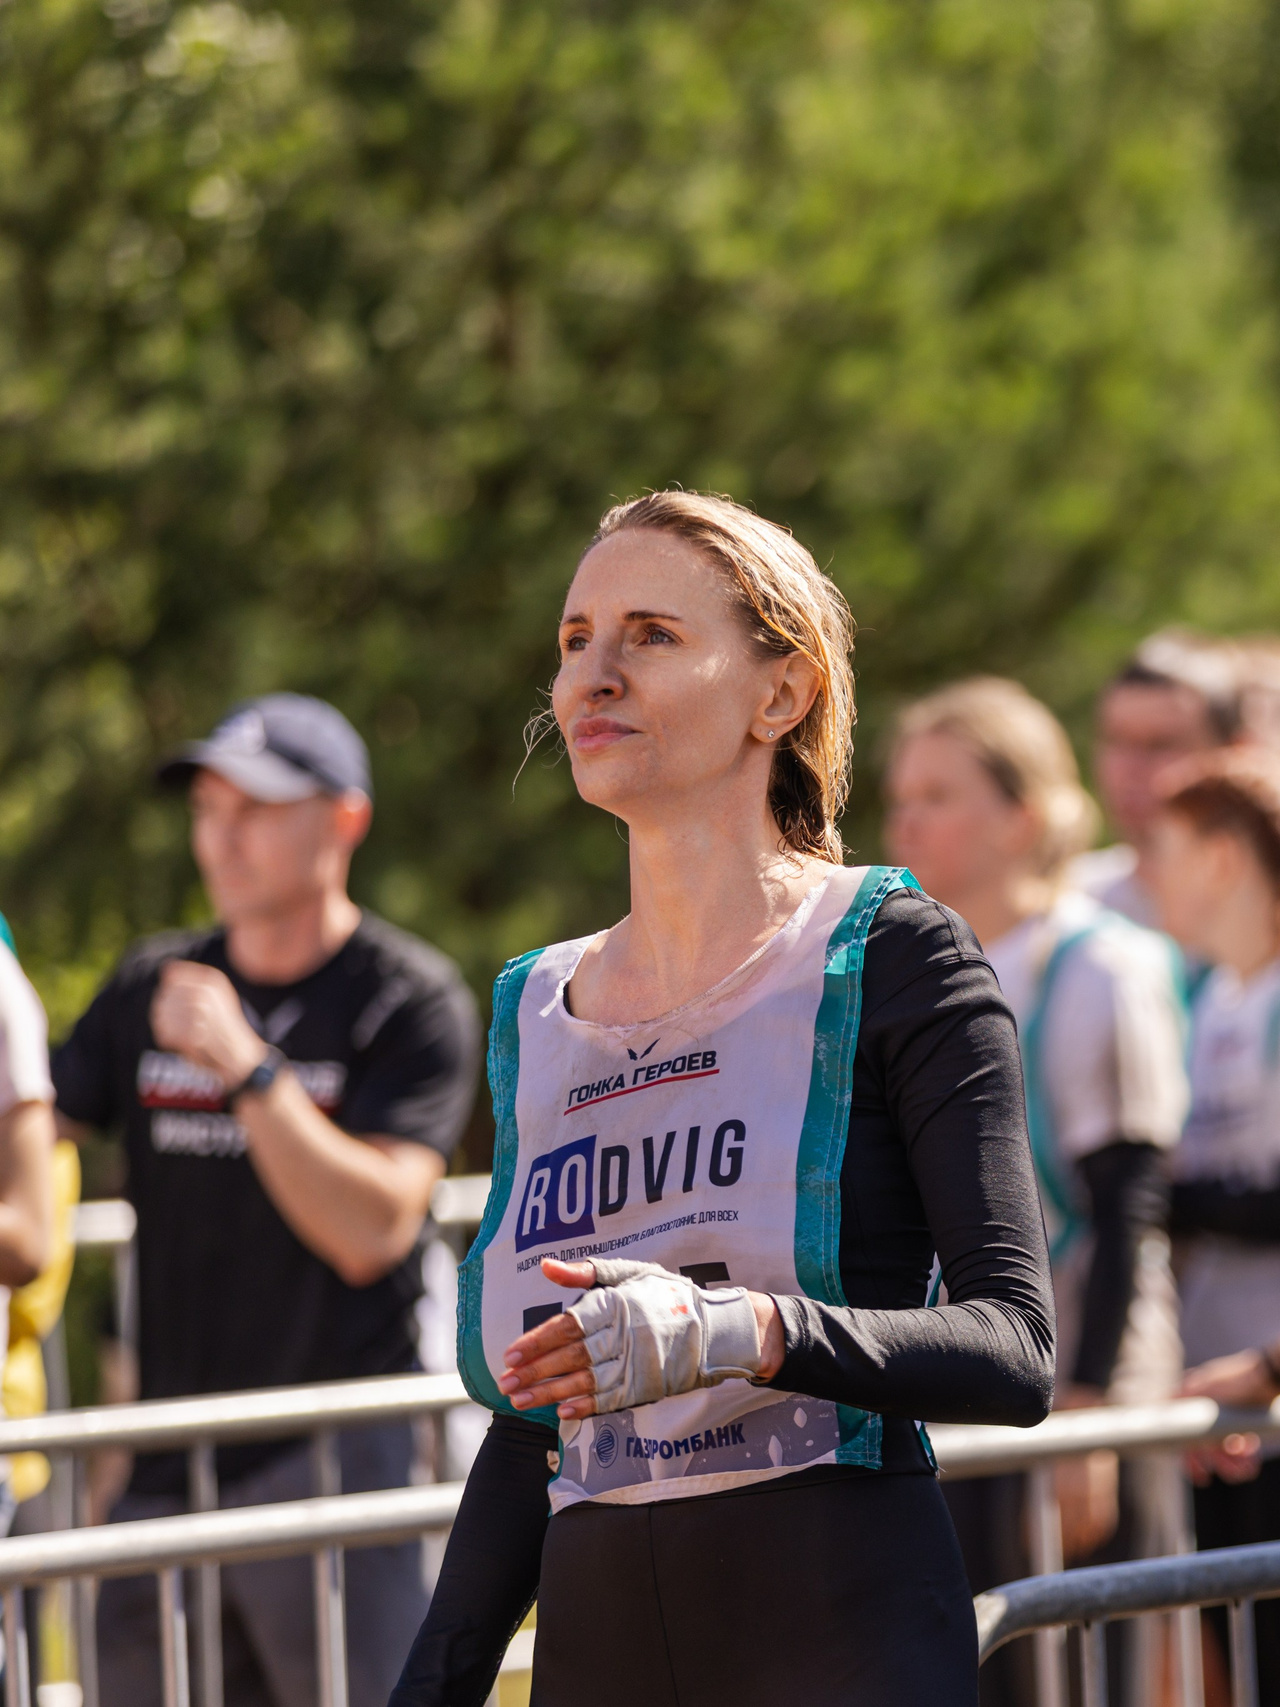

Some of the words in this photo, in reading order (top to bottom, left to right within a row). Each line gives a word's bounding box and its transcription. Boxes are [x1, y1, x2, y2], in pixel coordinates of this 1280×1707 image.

[567, 1073, 626, 1108] ГОНКА
[632, 1050, 717, 1086] ГЕРОЕВ
[521, 1119, 746, 1236] RODVIG
[560, 1248, 576, 1262] ДЛЯ
[698, 1210, 717, 1225] ДЛЯ
[717, 1209, 739, 1222] ВСЕХ
